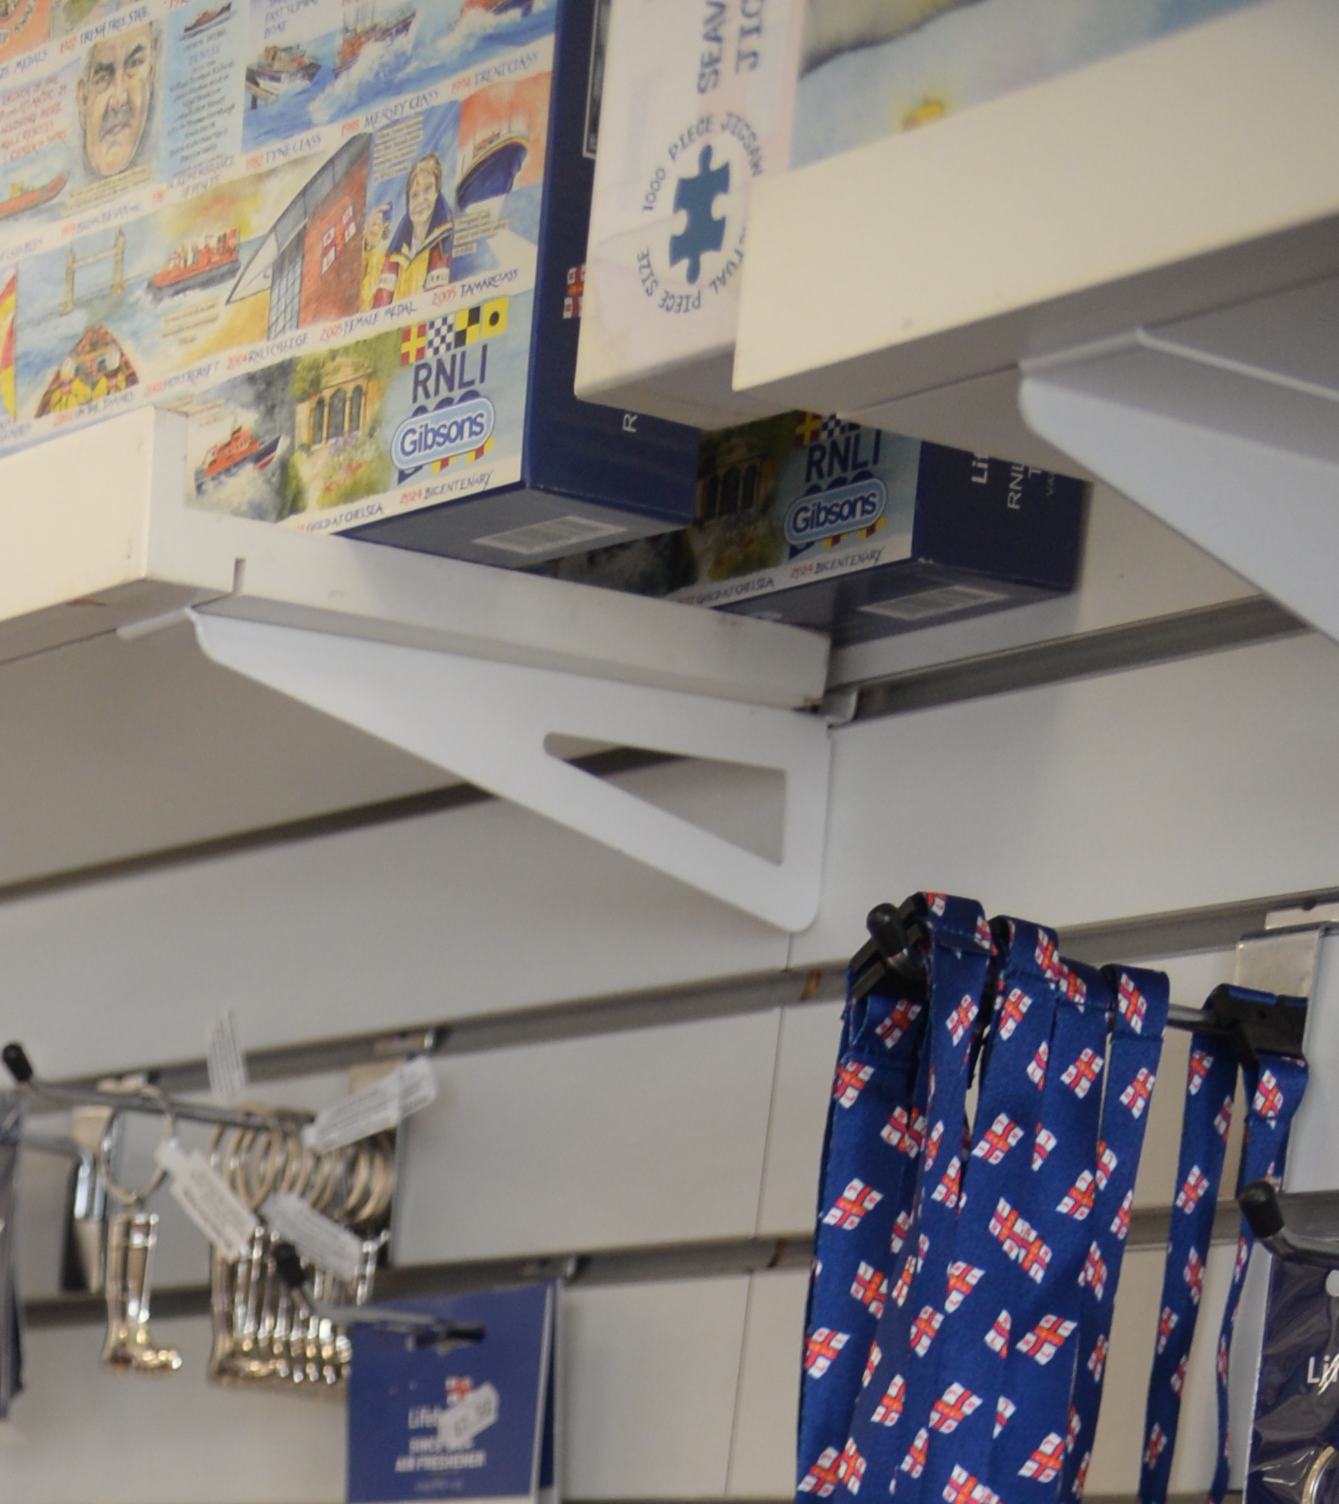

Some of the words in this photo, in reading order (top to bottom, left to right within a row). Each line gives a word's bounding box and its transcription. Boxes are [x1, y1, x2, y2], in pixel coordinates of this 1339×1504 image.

[642, 167, 666, 212] 1000
[668, 114, 714, 161] PIECE
[720, 111, 763, 177] JIGSAW
[637, 247, 659, 298] SIZE
[709, 226, 748, 294] TUAL
[658, 290, 701, 314] PIECE
[411, 343, 489, 404] RNLI
[399, 408, 486, 460] Gibsons
[804, 427, 882, 484] RNLI
[424, 469, 494, 500] BICENTENARY
[792, 491, 877, 533] Gibsons
